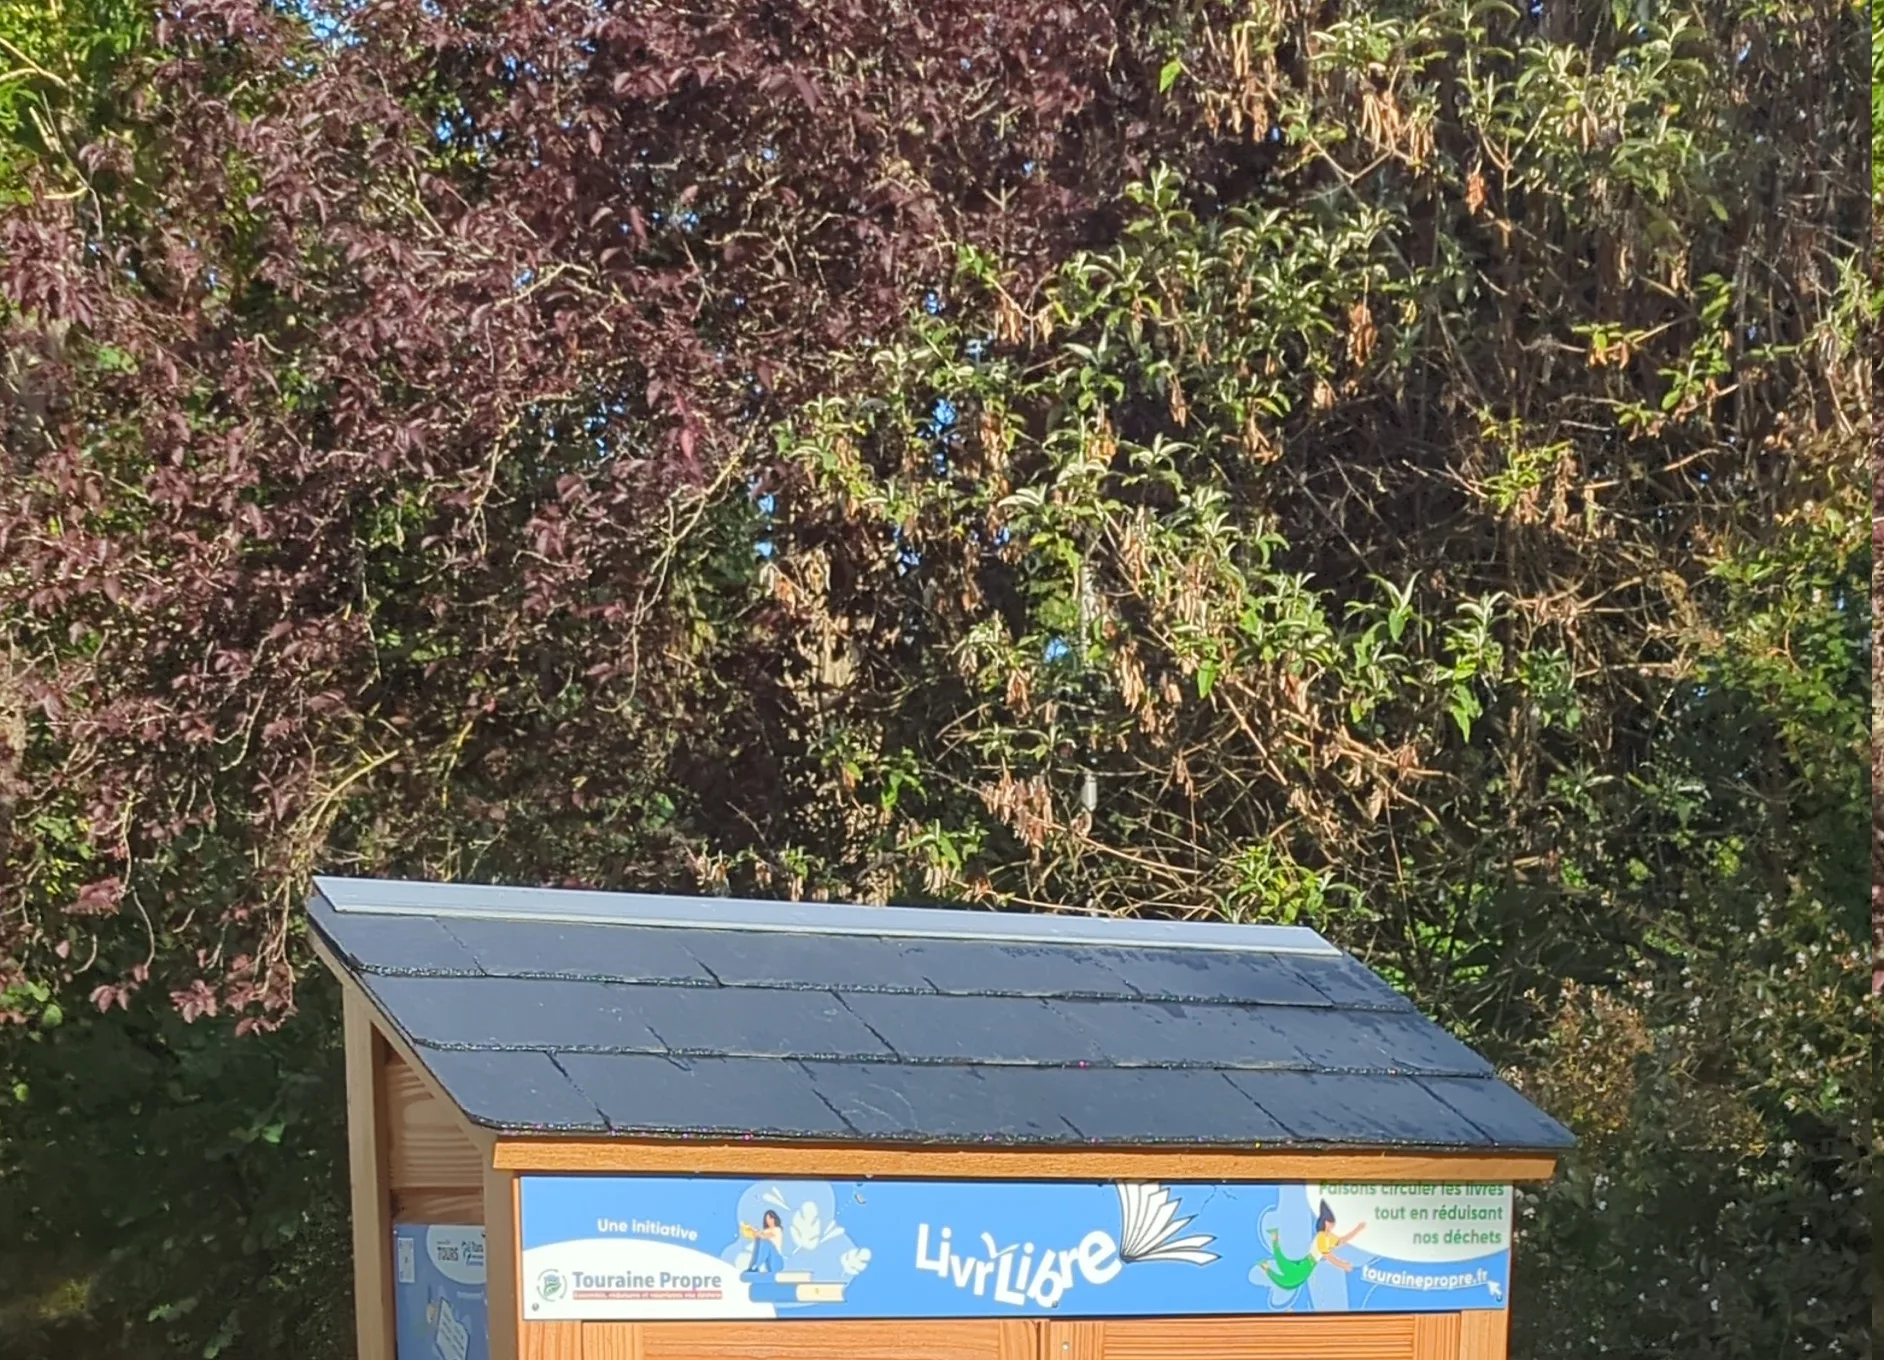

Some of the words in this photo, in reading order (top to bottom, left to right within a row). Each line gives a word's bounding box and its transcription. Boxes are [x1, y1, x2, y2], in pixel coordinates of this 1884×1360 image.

[1381, 1181, 1437, 1196] circuler
[1441, 1181, 1461, 1197] les
[1465, 1181, 1505, 1197] livres
[1374, 1206, 1406, 1221] tout
[1411, 1208, 1428, 1220] en
[1432, 1204, 1503, 1221] réduisant
[597, 1217, 628, 1233] Une
[632, 1219, 698, 1242] initiative
[1412, 1231, 1439, 1245] nos
[1443, 1229, 1502, 1245] déchets
[572, 1270, 655, 1288] Touraine
[660, 1271, 722, 1290] Propre
[1362, 1265, 1488, 1291] tourainepropre.fr
